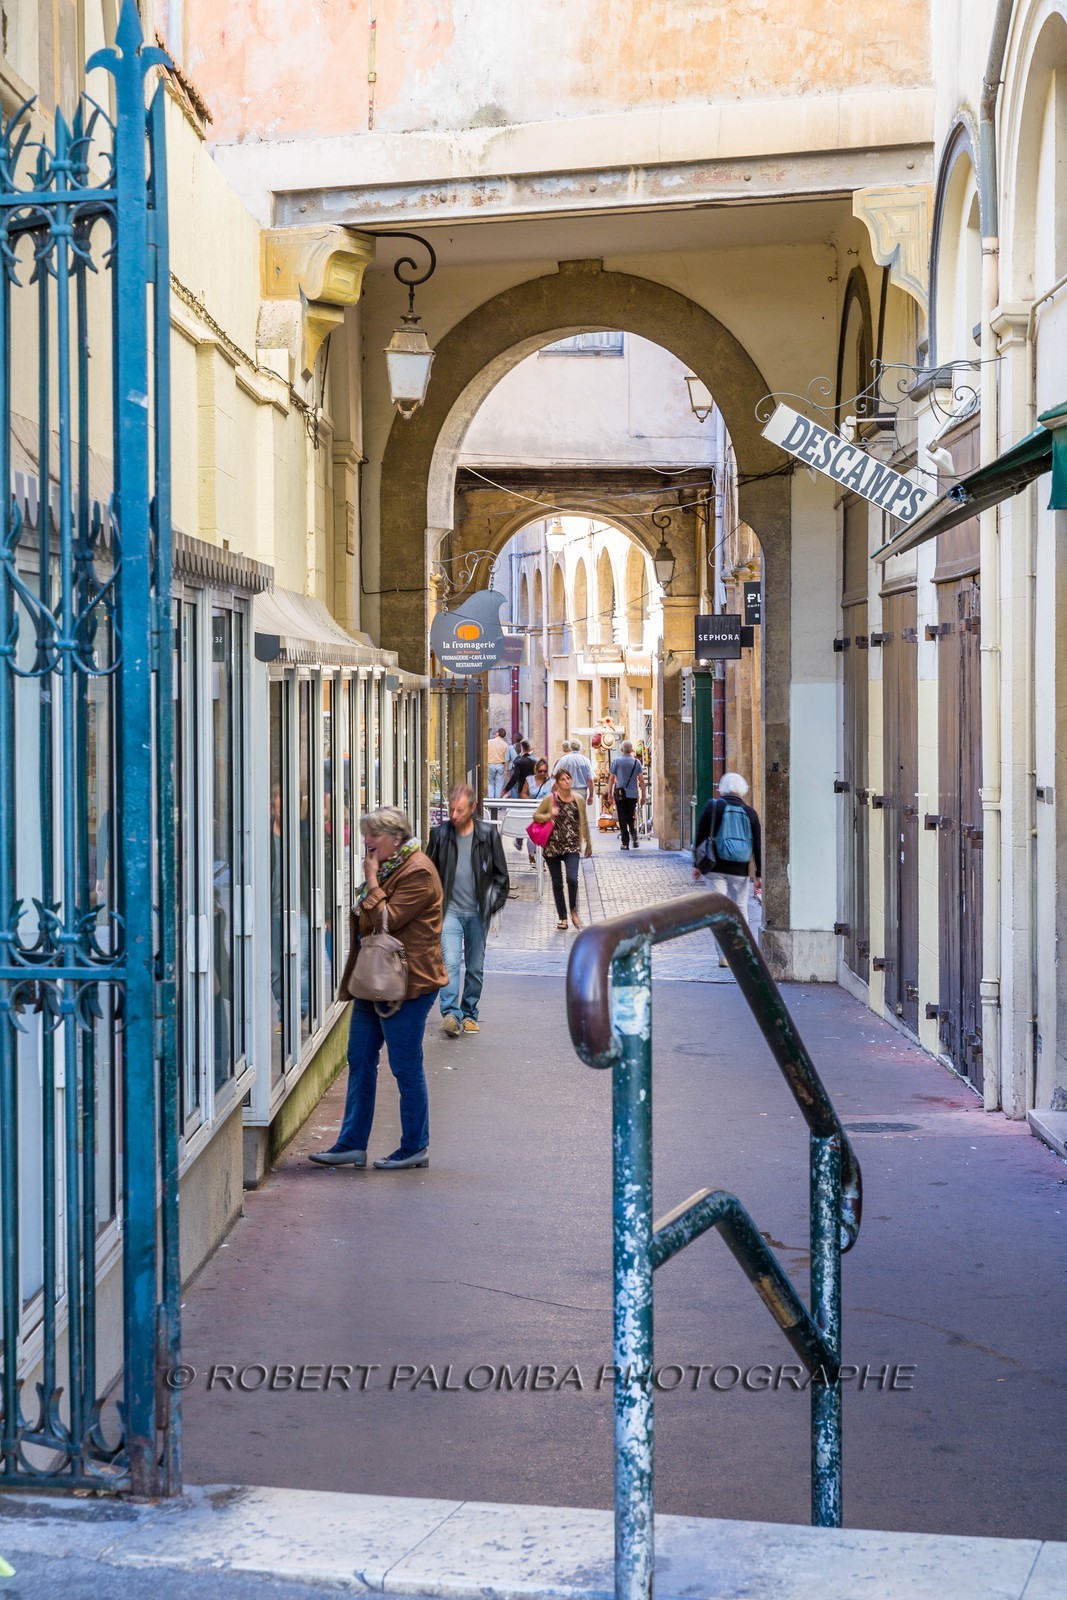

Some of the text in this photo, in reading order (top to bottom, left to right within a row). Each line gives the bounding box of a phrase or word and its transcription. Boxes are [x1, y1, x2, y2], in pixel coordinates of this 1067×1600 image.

[780, 415, 928, 521] DESCAMPS
[442, 641, 450, 649] la
[452, 640, 495, 650] fromagerie
